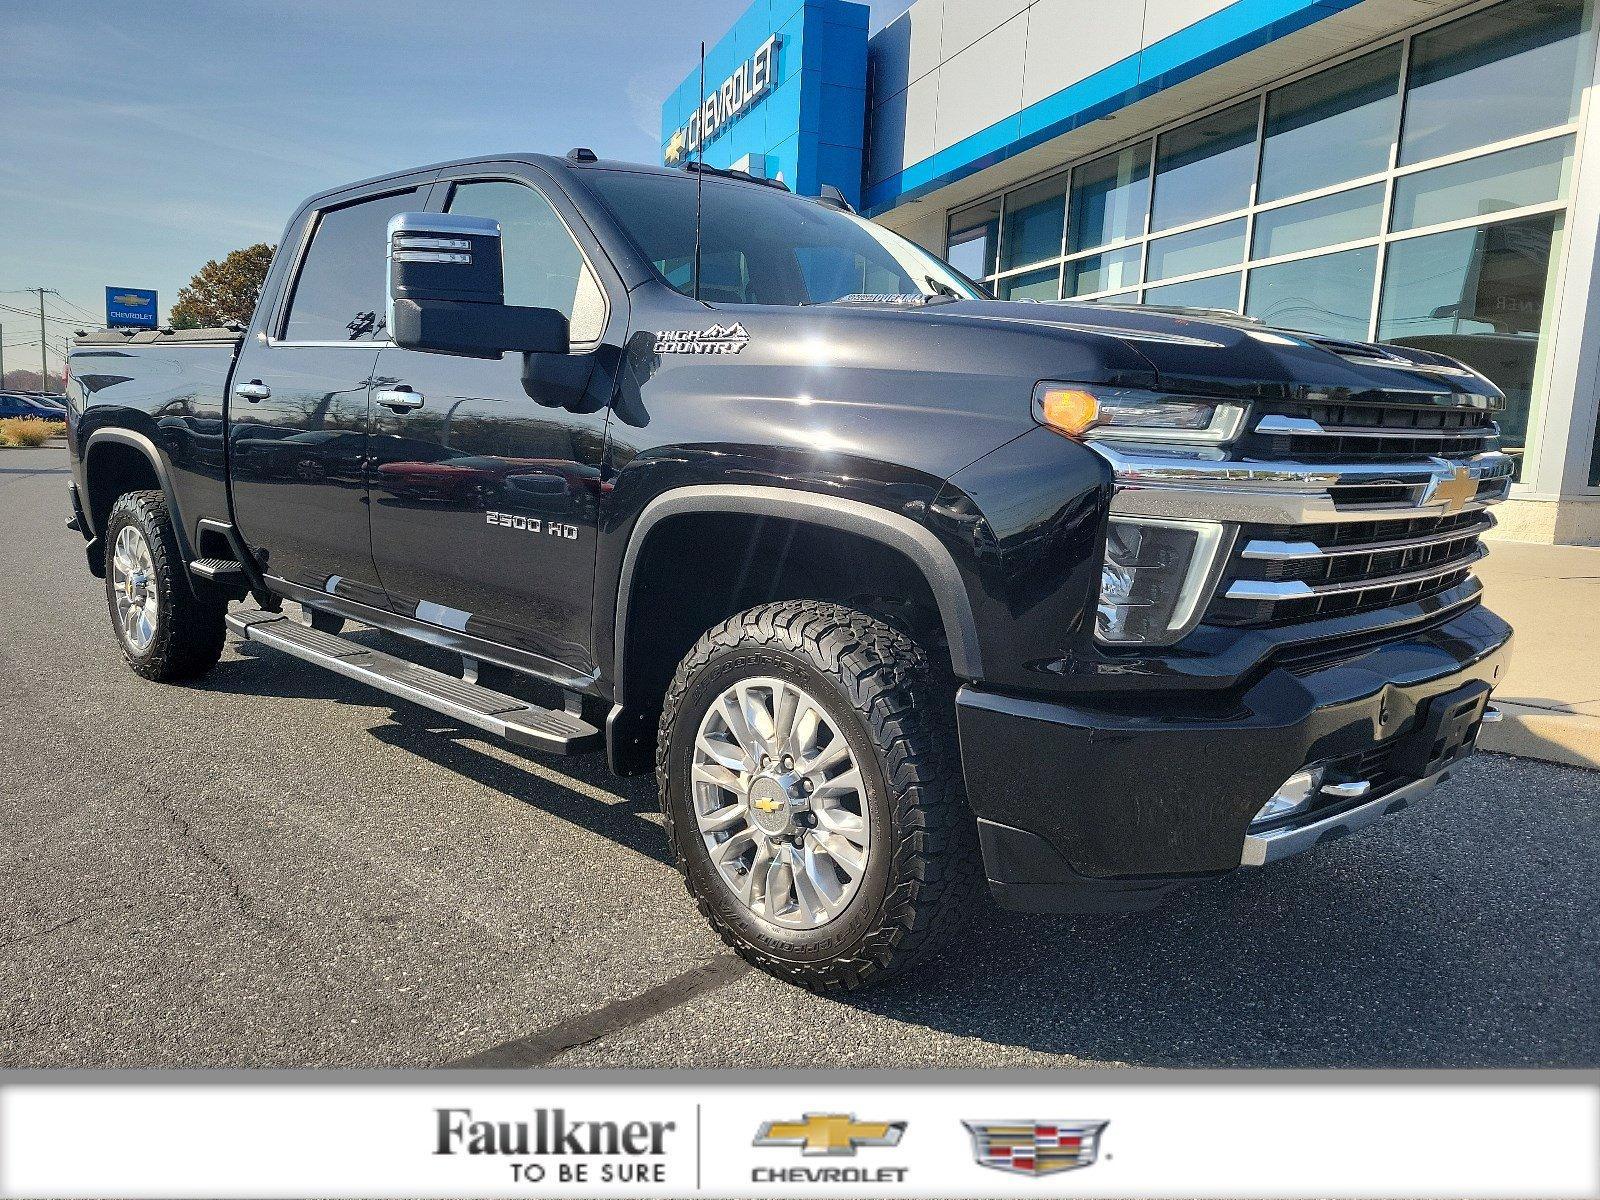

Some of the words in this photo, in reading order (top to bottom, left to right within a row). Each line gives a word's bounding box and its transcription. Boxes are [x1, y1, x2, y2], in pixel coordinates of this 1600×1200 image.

[688, 32, 780, 152] CHEVROLET
[110, 311, 153, 320] CHEVROLET
[656, 330, 704, 342] HIGH
[652, 341, 748, 356] COUNTRY
[486, 510, 542, 533] 2500
[547, 521, 579, 540] HD
